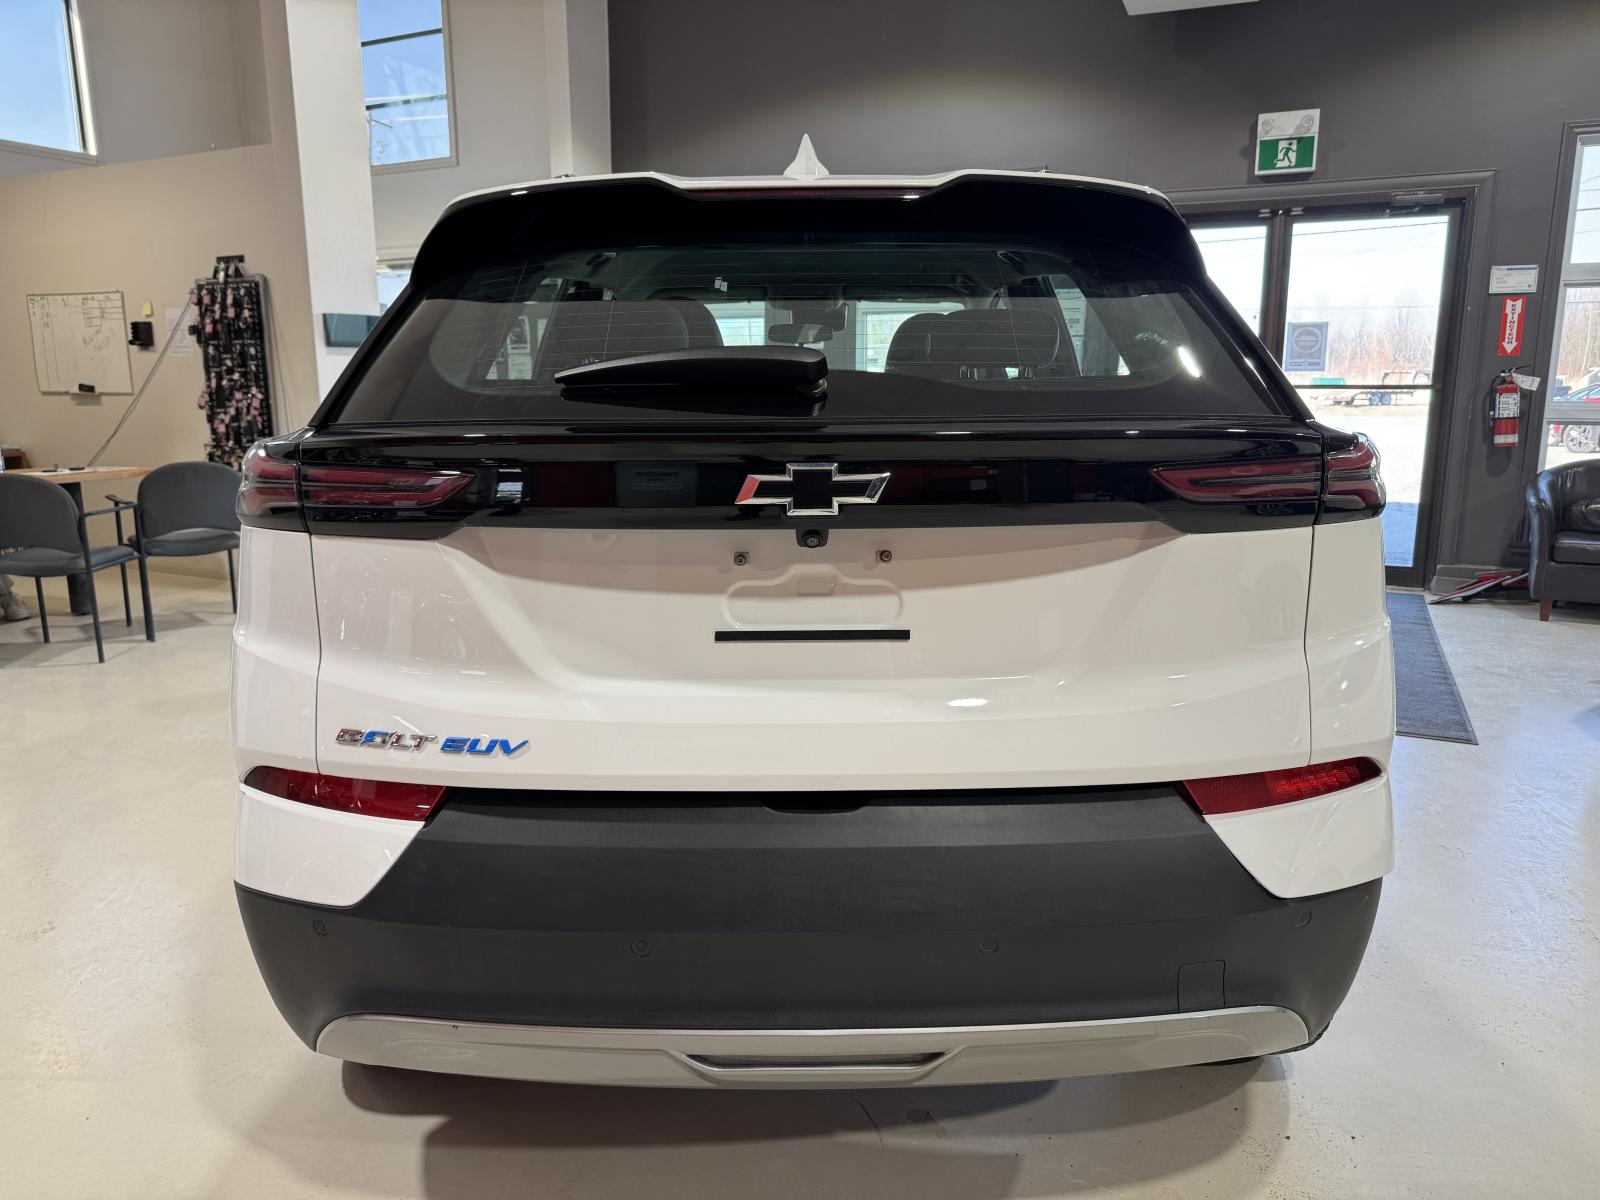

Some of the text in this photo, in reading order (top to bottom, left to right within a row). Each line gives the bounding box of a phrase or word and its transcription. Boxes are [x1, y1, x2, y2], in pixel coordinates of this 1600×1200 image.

[1506, 303, 1517, 344] EXTINCTEUR
[335, 727, 530, 757] BOLT EUV
